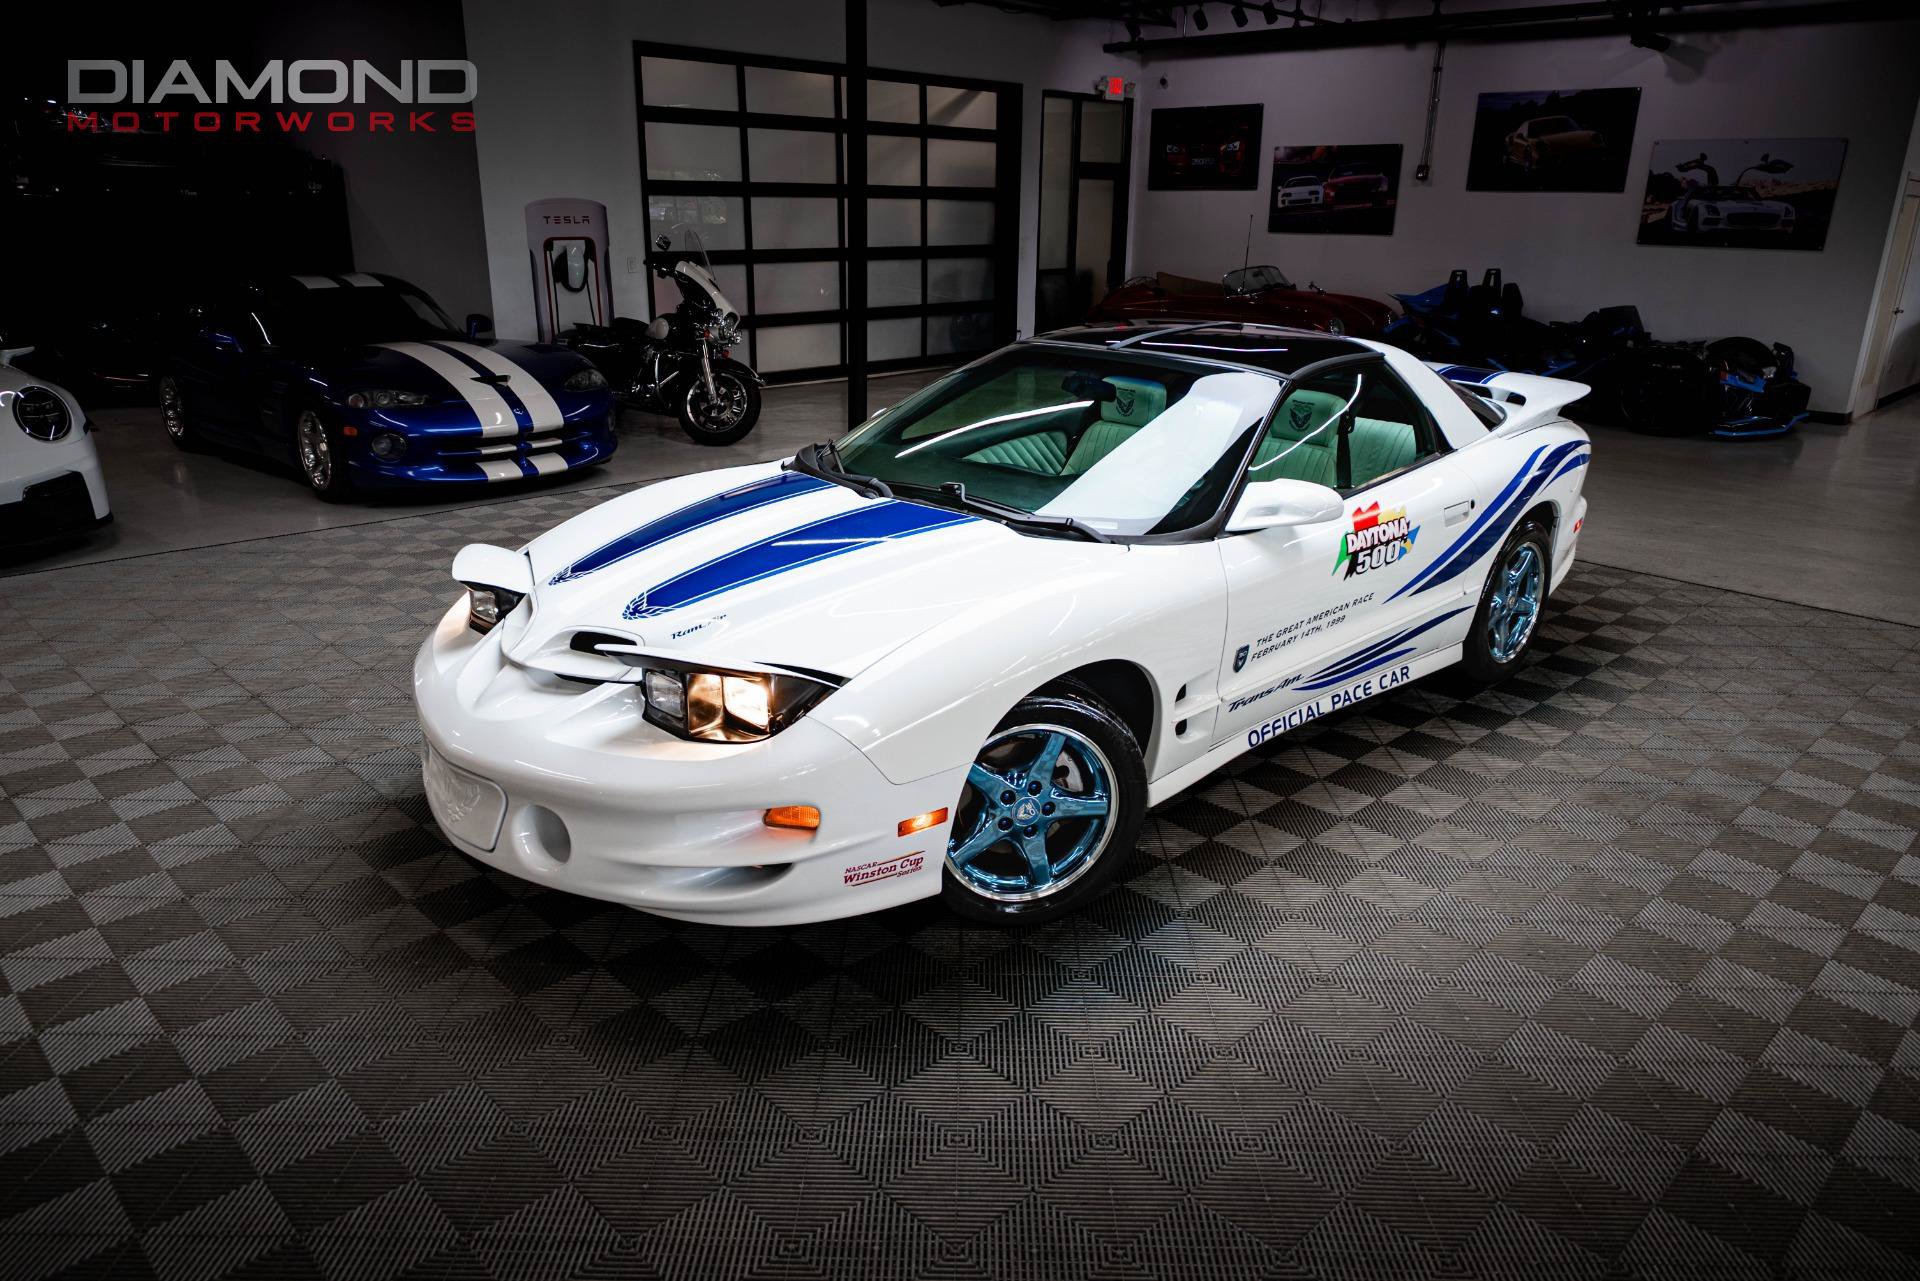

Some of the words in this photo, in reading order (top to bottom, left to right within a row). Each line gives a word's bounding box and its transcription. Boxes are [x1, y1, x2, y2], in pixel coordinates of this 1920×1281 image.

[543, 215, 590, 225] TESLA
[1345, 516, 1410, 555] DAYTONA
[1355, 540, 1402, 575] 500
[1257, 634, 1275, 648] THE
[1276, 620, 1305, 639] GREAT
[1302, 601, 1351, 628] AMERICAN
[1350, 592, 1375, 608] RACE
[1250, 636, 1298, 662] FEBRUARY
[1325, 614, 1346, 629] 1999
[1247, 702, 1326, 749] OFFICIAL
[1331, 680, 1373, 711] PACE
[1379, 665, 1411, 690] CAR
[843, 863, 897, 885] Winston
[900, 856, 924, 870] Cup
[845, 861, 878, 874] NASCAR
[896, 865, 923, 878] Series
